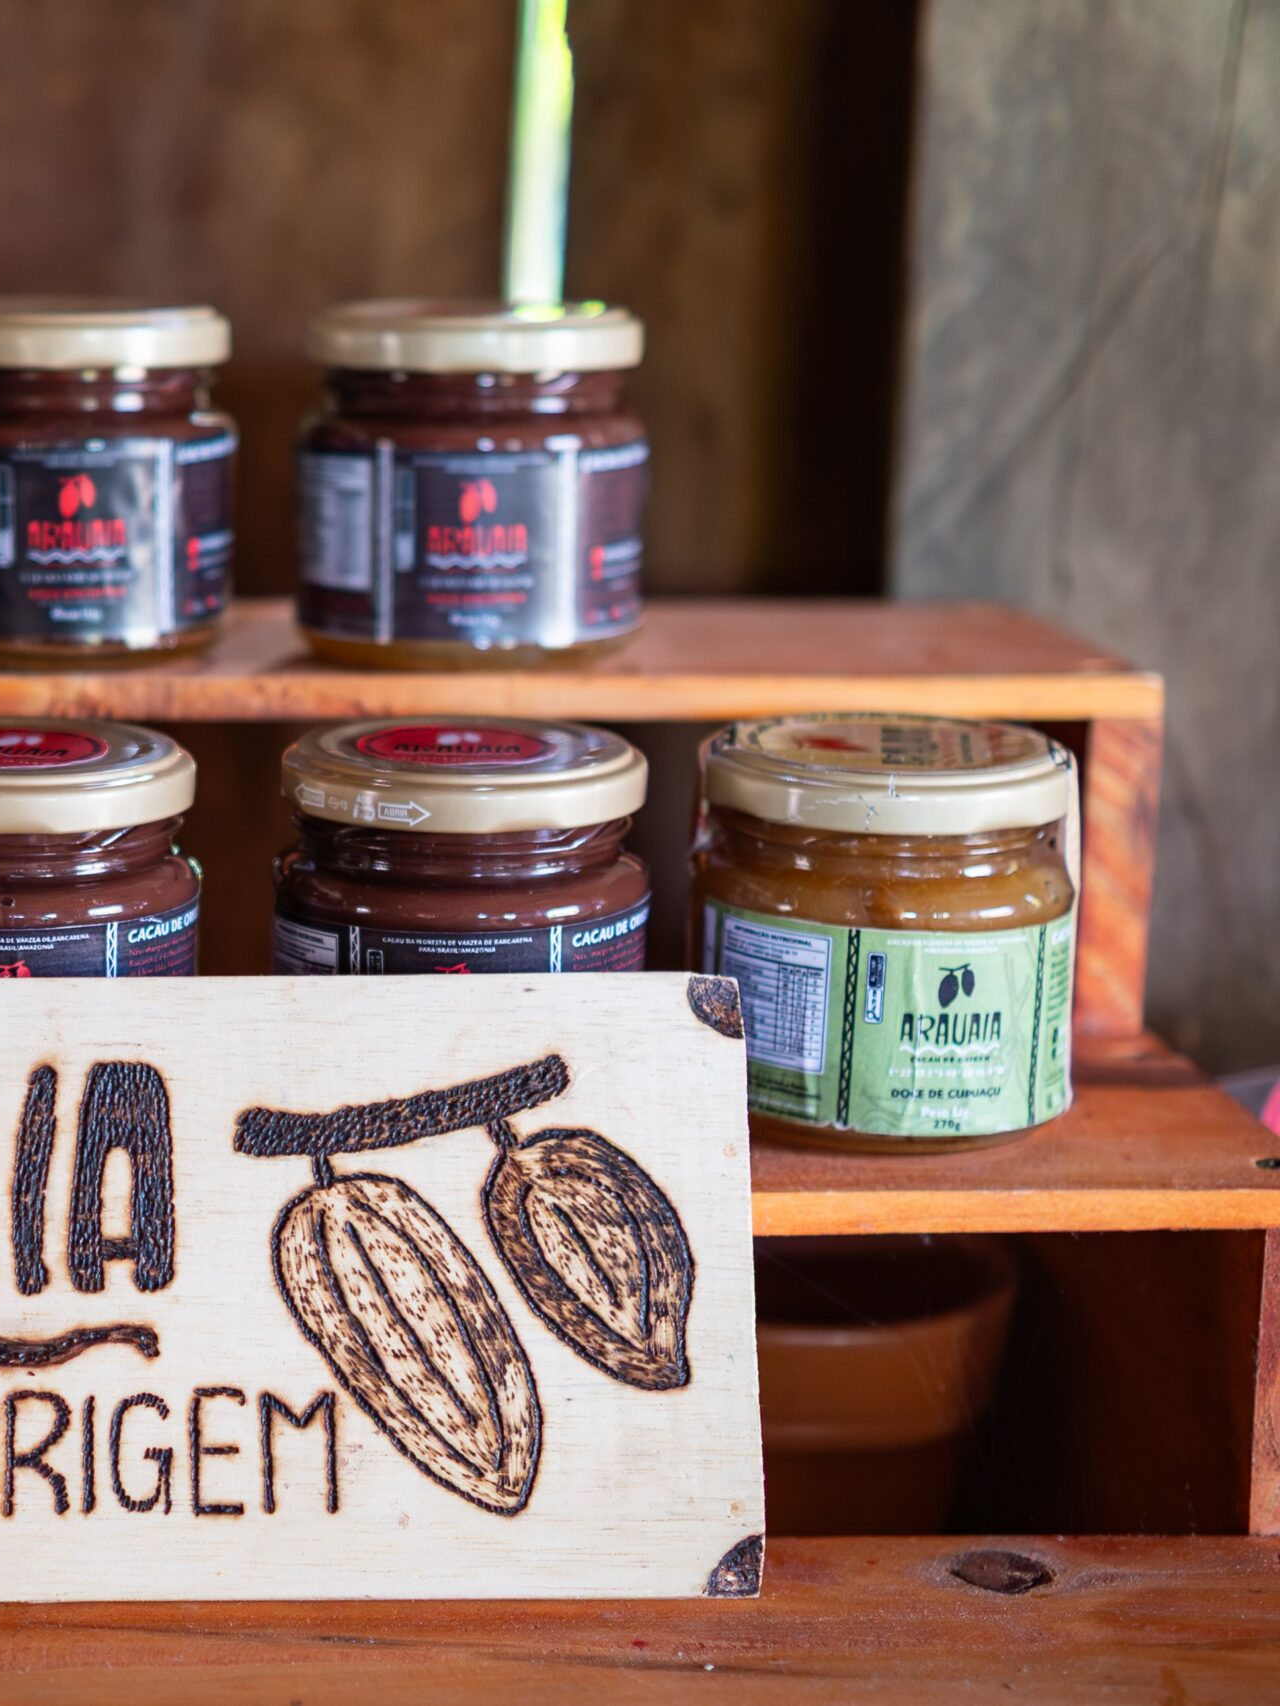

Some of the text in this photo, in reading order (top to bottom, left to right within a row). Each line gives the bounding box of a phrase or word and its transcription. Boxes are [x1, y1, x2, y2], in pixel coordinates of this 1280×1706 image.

[51, 933, 90, 942] BARCARENA
[128, 922, 170, 944] CACAU
[170, 916, 183, 932] DE
[572, 919, 628, 948] CACAU DE
[382, 936, 405, 945] CACAU
[415, 938, 447, 946] FLORESTA
[493, 936, 533, 945] BARCARENA
[900, 1011, 1002, 1046] ARAUAIA
[891, 1086, 1002, 1101] DOCE DE CUPUAÇU
[933, 1119, 962, 1132] 270g
